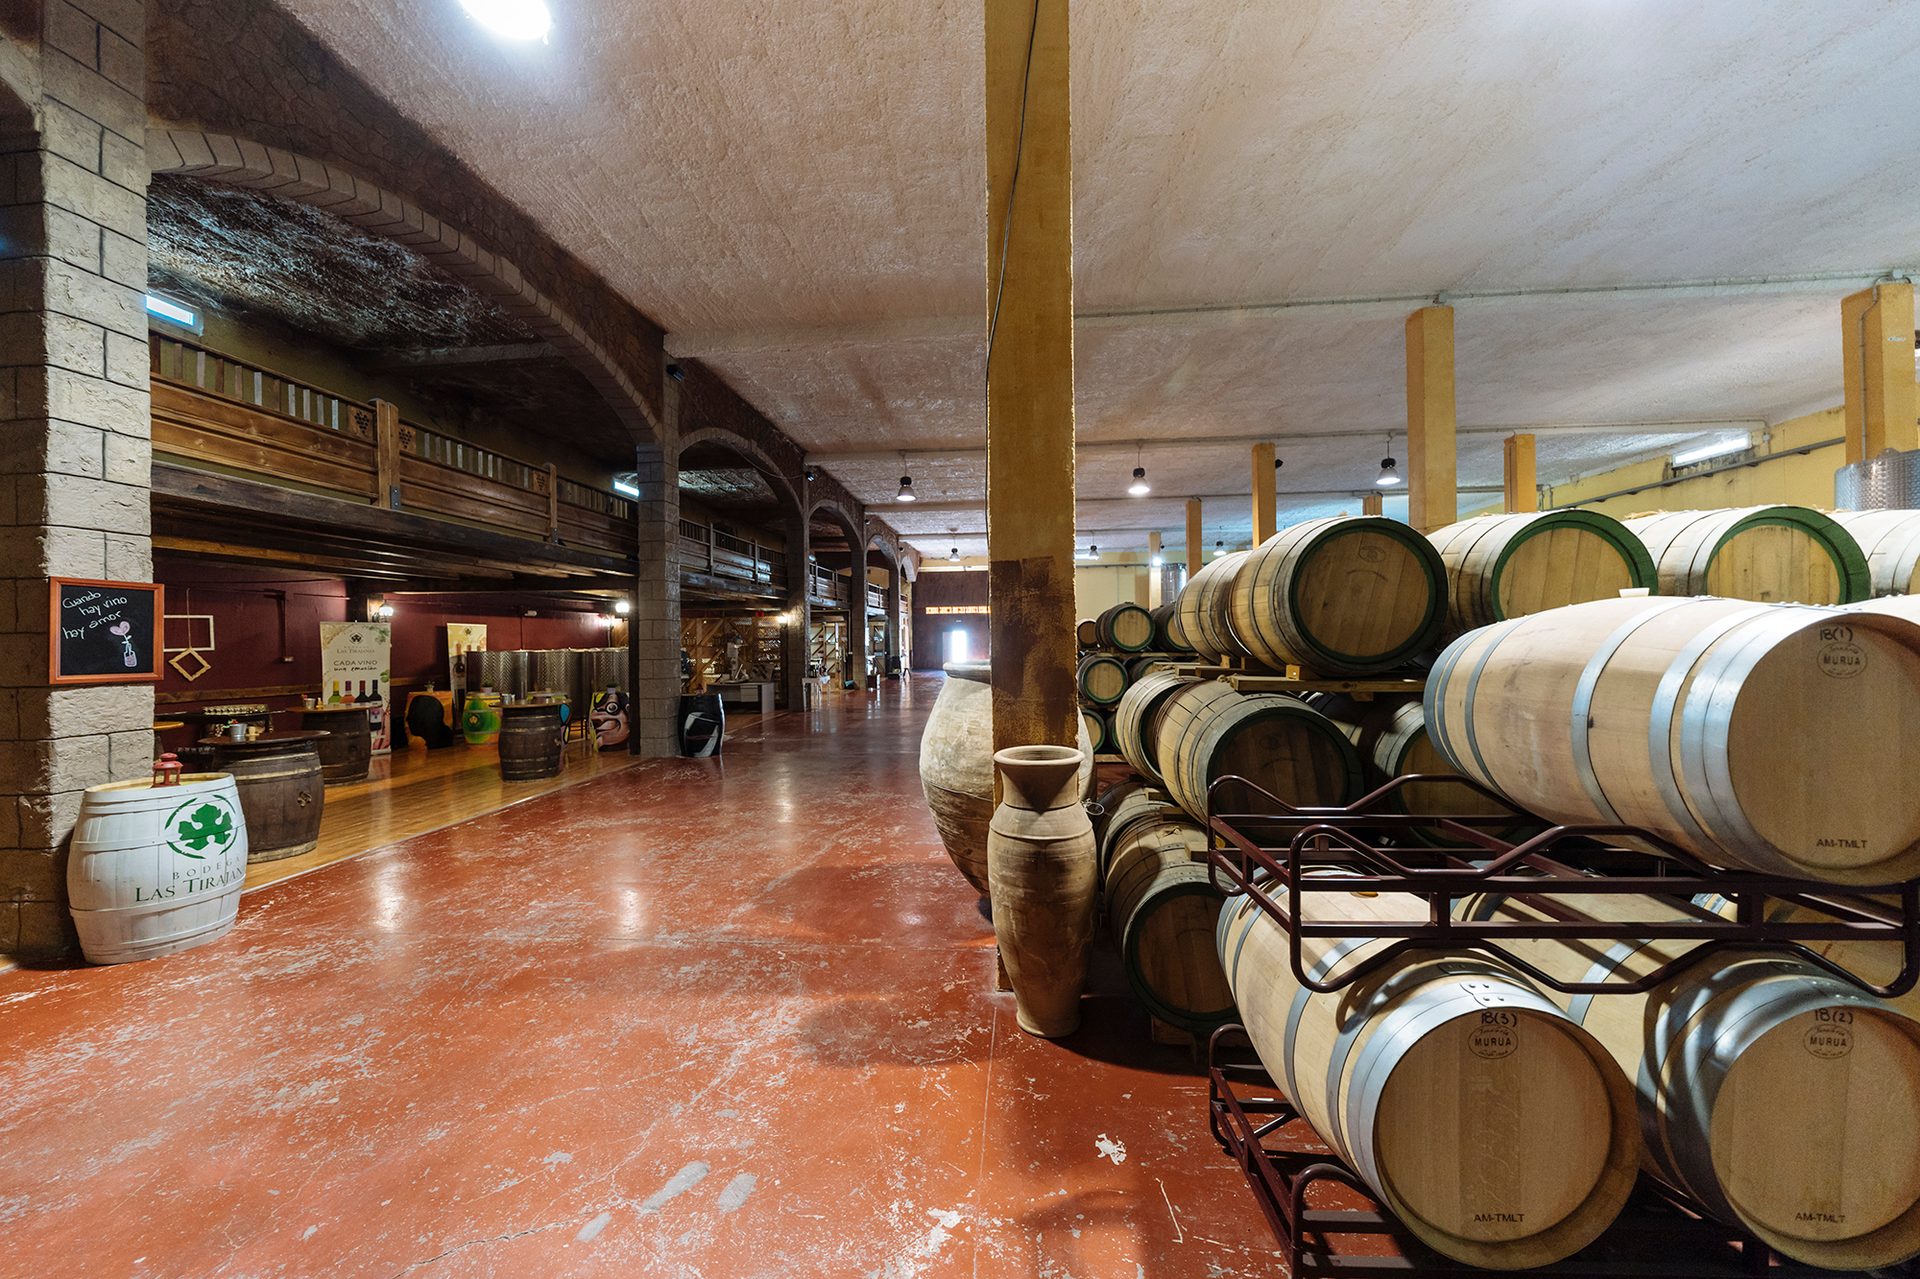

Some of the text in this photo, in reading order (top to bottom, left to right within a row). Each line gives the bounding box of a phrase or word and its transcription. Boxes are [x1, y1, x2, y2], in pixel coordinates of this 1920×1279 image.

[62, 591, 101, 608] Cuando
[79, 596, 127, 615] hay vino
[62, 611, 121, 639] hay amor
[1823, 655, 1860, 665] MURUA
[135, 885, 175, 902] LAS
[1474, 1037, 1511, 1046] MURUA
[1810, 1036, 1847, 1047] MURUA
